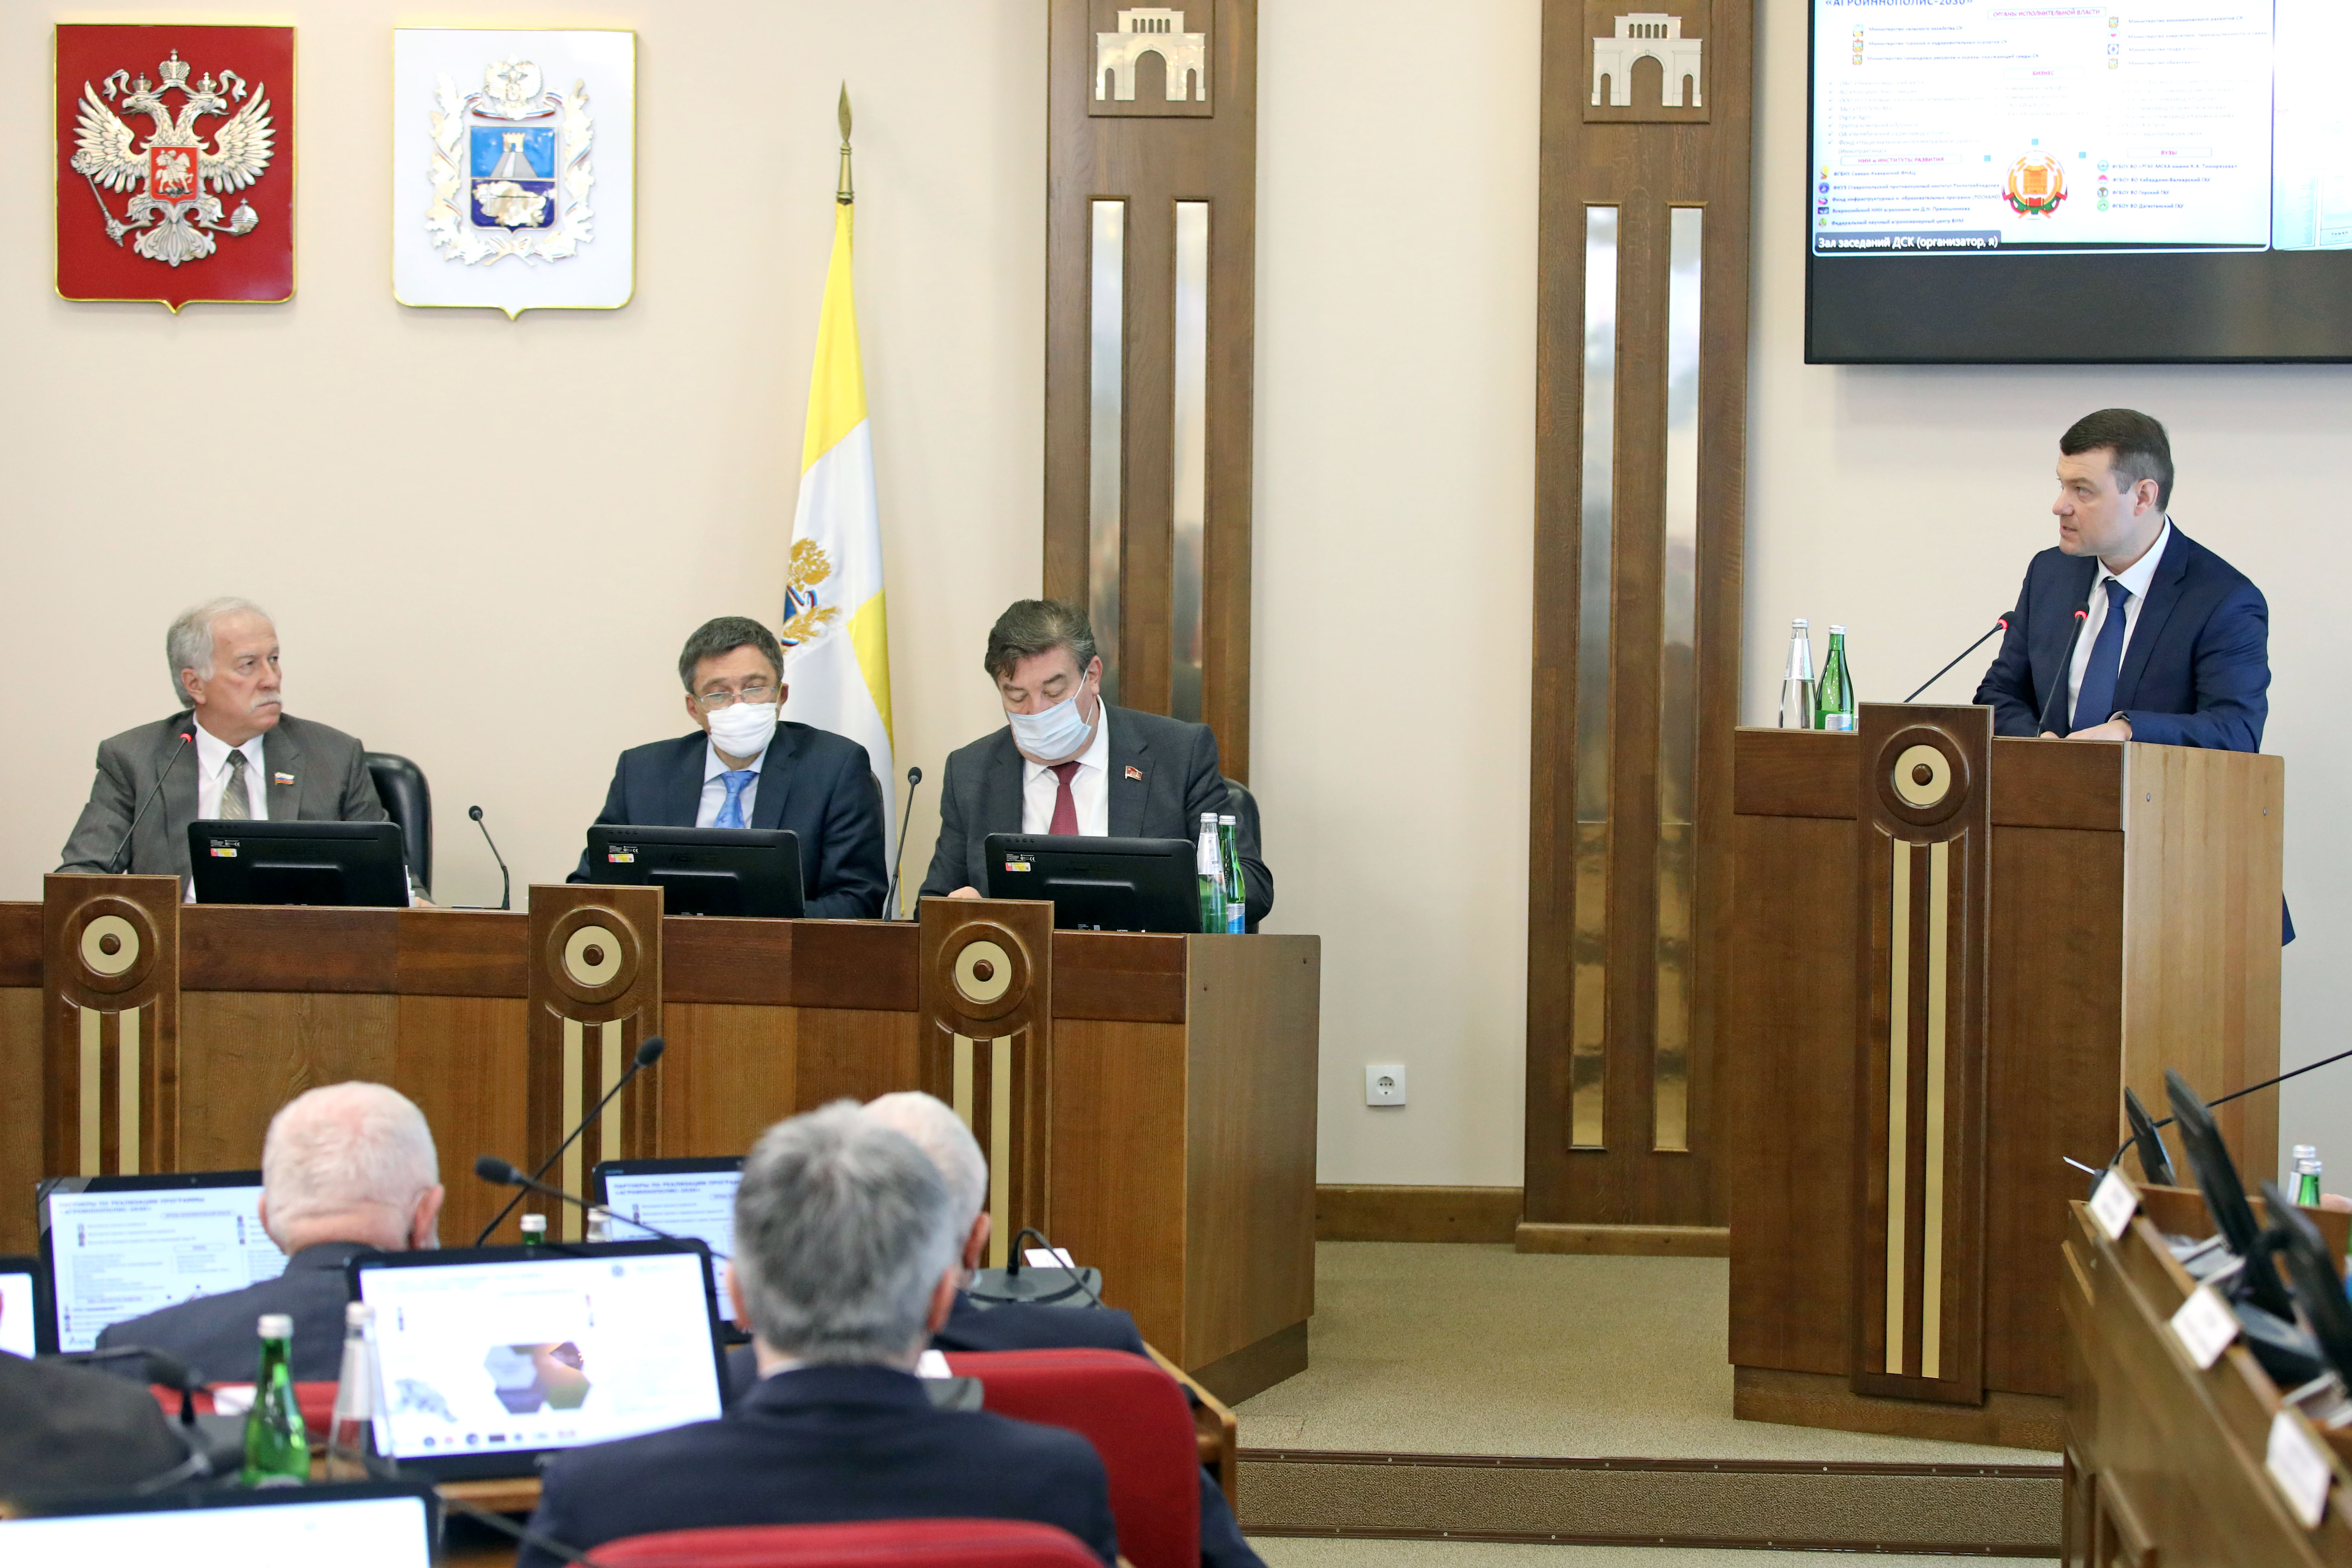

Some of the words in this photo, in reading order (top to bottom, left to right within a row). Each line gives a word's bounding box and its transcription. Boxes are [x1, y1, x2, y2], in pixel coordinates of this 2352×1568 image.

[2019, 8, 2075, 16] ИСПОЛНИТЕЛЬНОЙ
[1818, 237, 1836, 248] Зал
[1838, 237, 1891, 249] заседаний
[1892, 237, 1914, 249] ДСК
[1916, 236, 1986, 249] (организатор,
[1988, 235, 1998, 248] я)
